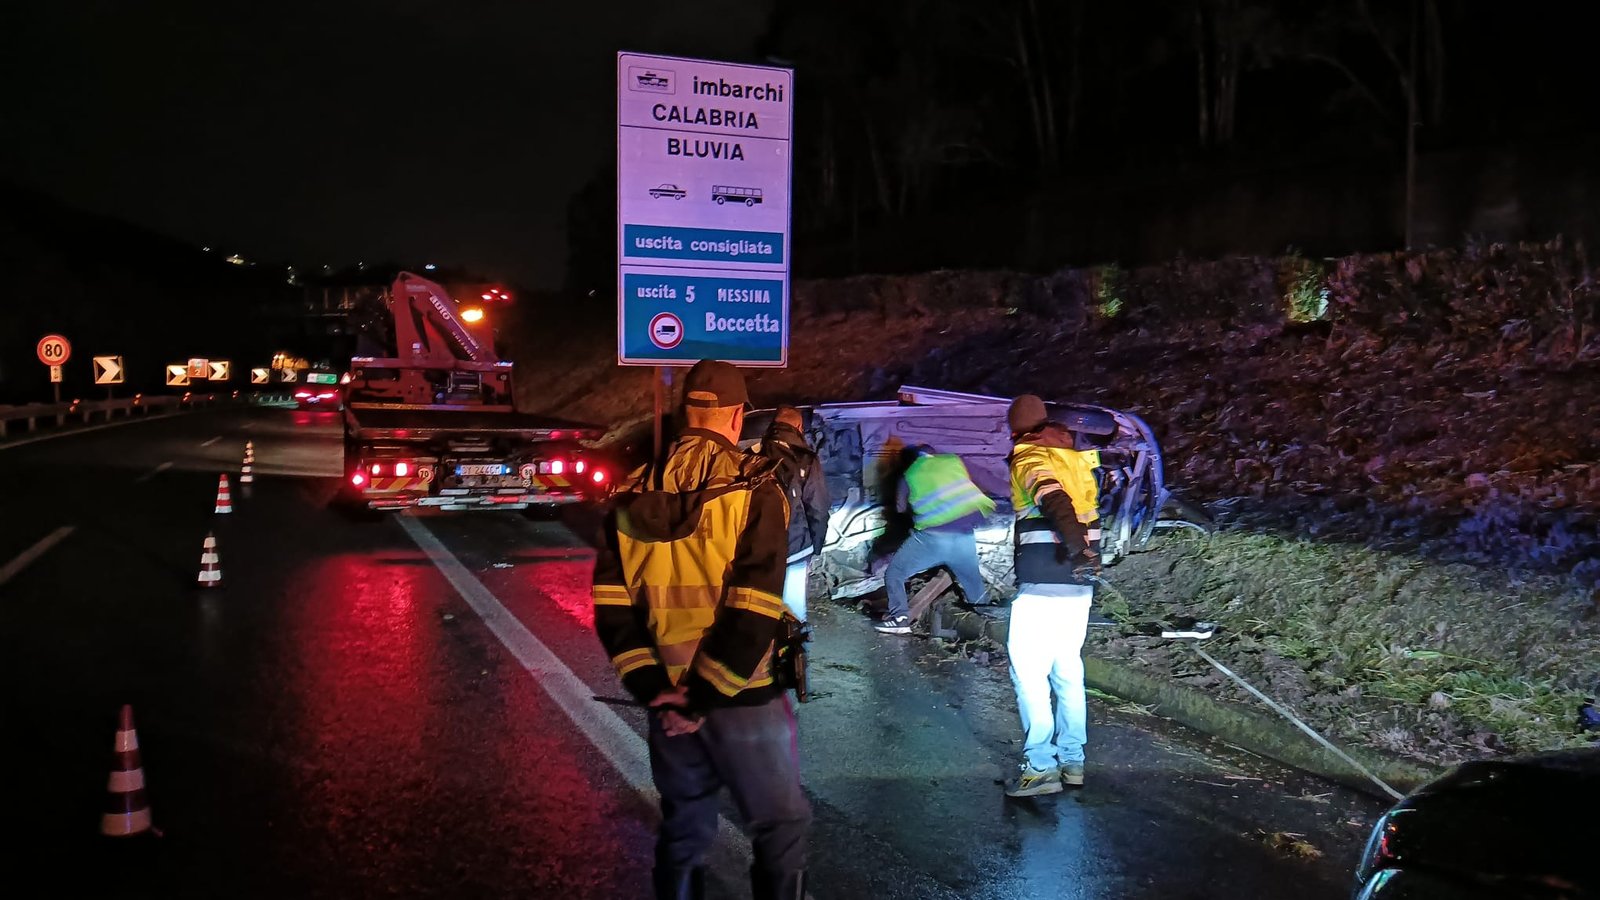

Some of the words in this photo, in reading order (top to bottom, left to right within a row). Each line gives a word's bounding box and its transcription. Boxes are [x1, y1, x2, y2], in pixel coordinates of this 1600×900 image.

[693, 76, 783, 102] imbarchi
[652, 103, 759, 129] CALABRIA
[667, 138, 745, 161] BLUVIA
[635, 236, 683, 251] uscita
[690, 240, 773, 256] consigliata
[637, 284, 677, 299] uscita
[685, 285, 696, 303] 5
[717, 288, 770, 303] MESSINA
[705, 312, 780, 333] Boccetta
[45, 343, 63, 357] 80
[419, 470, 429, 478] 70
